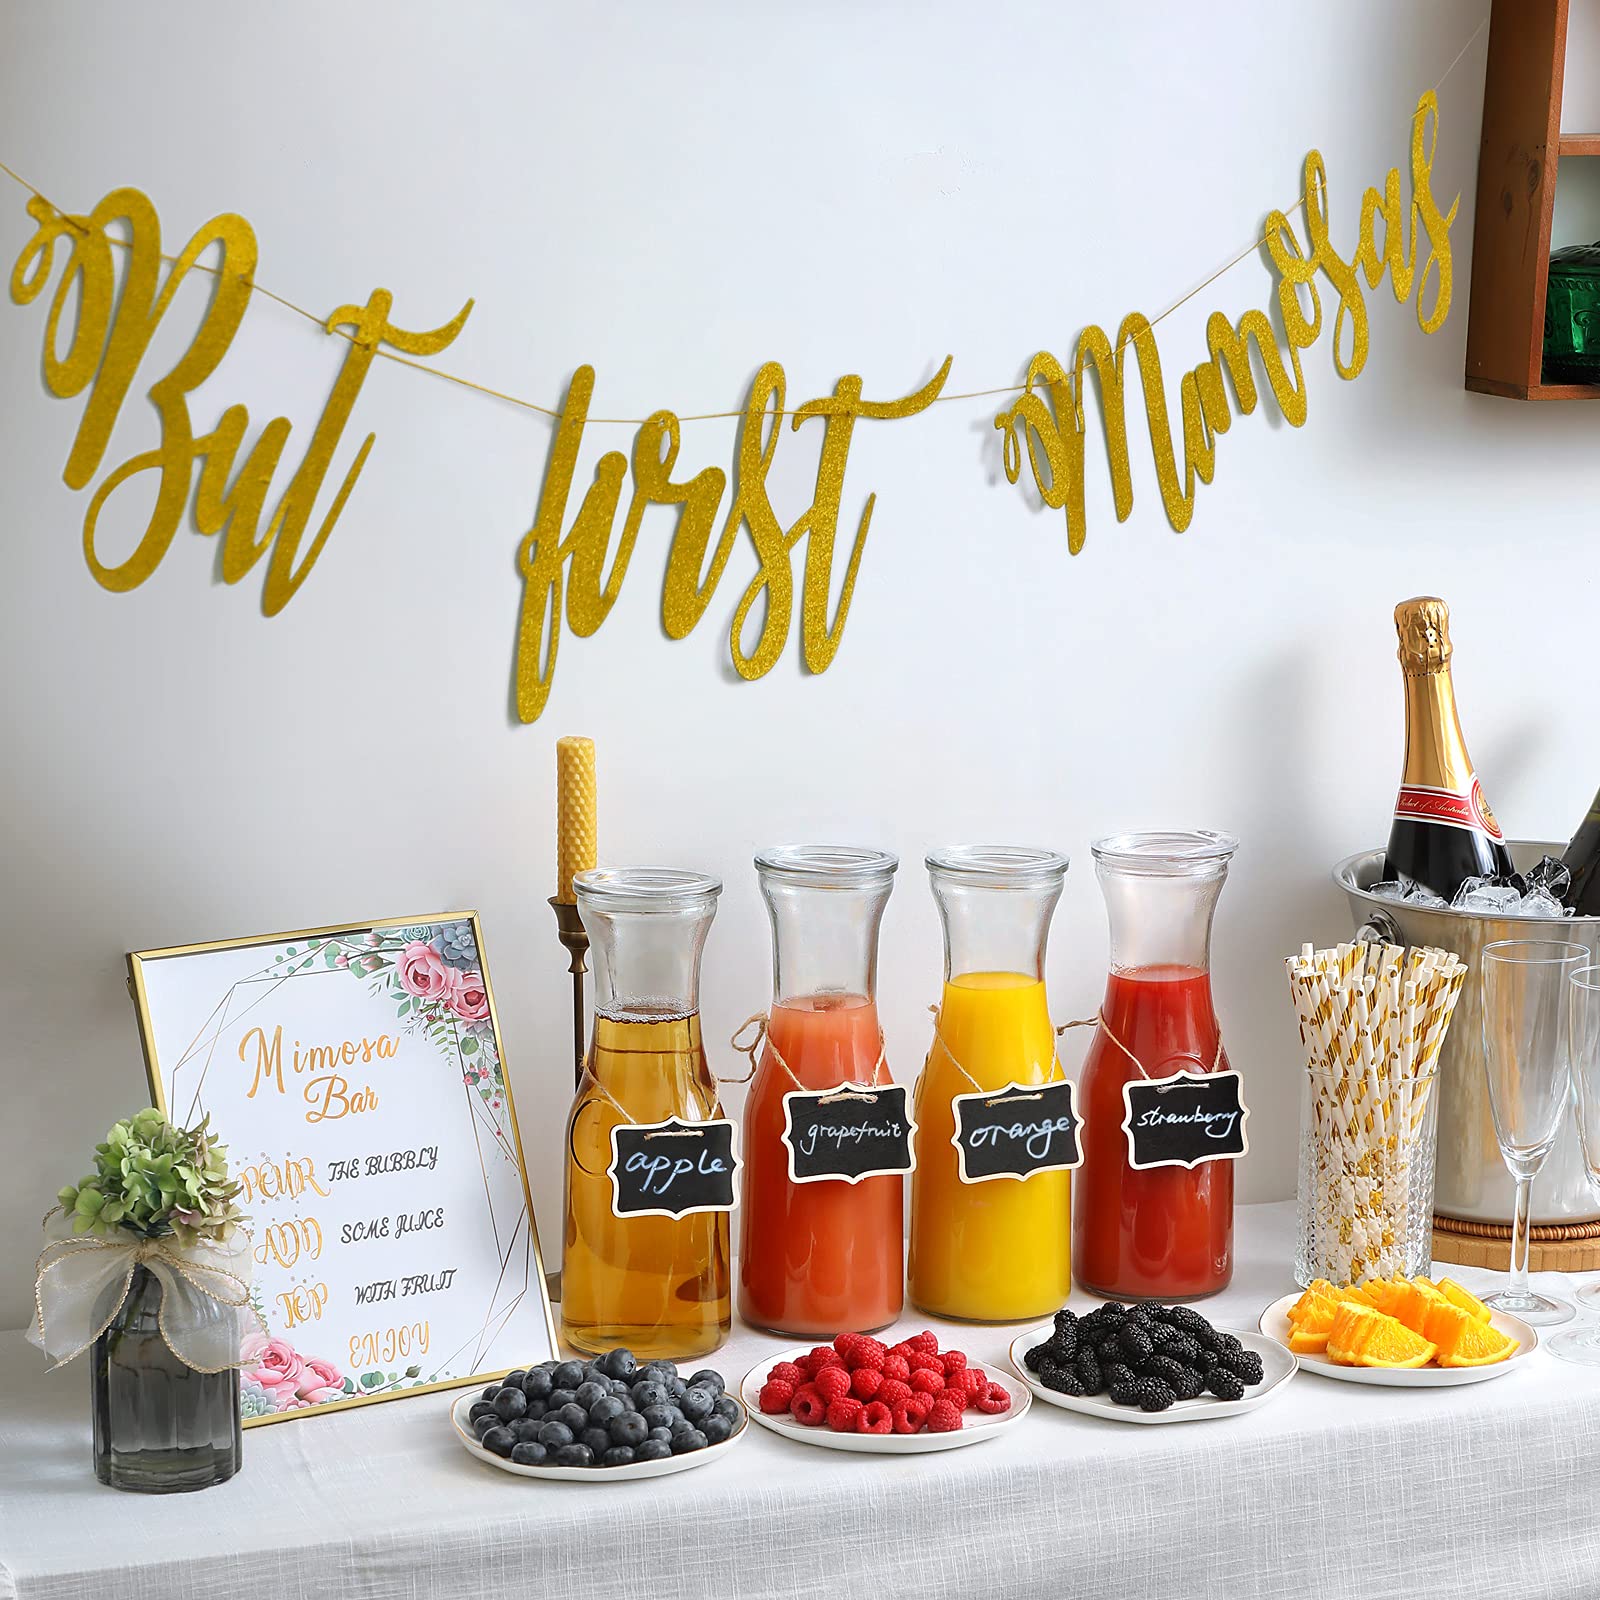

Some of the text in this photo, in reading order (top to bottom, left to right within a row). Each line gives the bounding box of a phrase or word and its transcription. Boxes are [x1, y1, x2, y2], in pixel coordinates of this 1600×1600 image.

[11, 89, 1461, 724] But first Mimosas
[238, 1024, 400, 1099] Mimosa
[303, 1073, 379, 1124] Bar
[1136, 1104, 1239, 1139] strawberry
[800, 1119, 902, 1155] grapefruit
[968, 1115, 1070, 1159] orange
[236, 1145, 439, 1204] POUR THE BUBBLY
[625, 1148, 728, 1194] apple
[253, 1207, 445, 1269] ADD SOME JUICE
[275, 1268, 458, 1329] TOP WITH FRUIT
[348, 1320, 430, 1369] ENJOY
